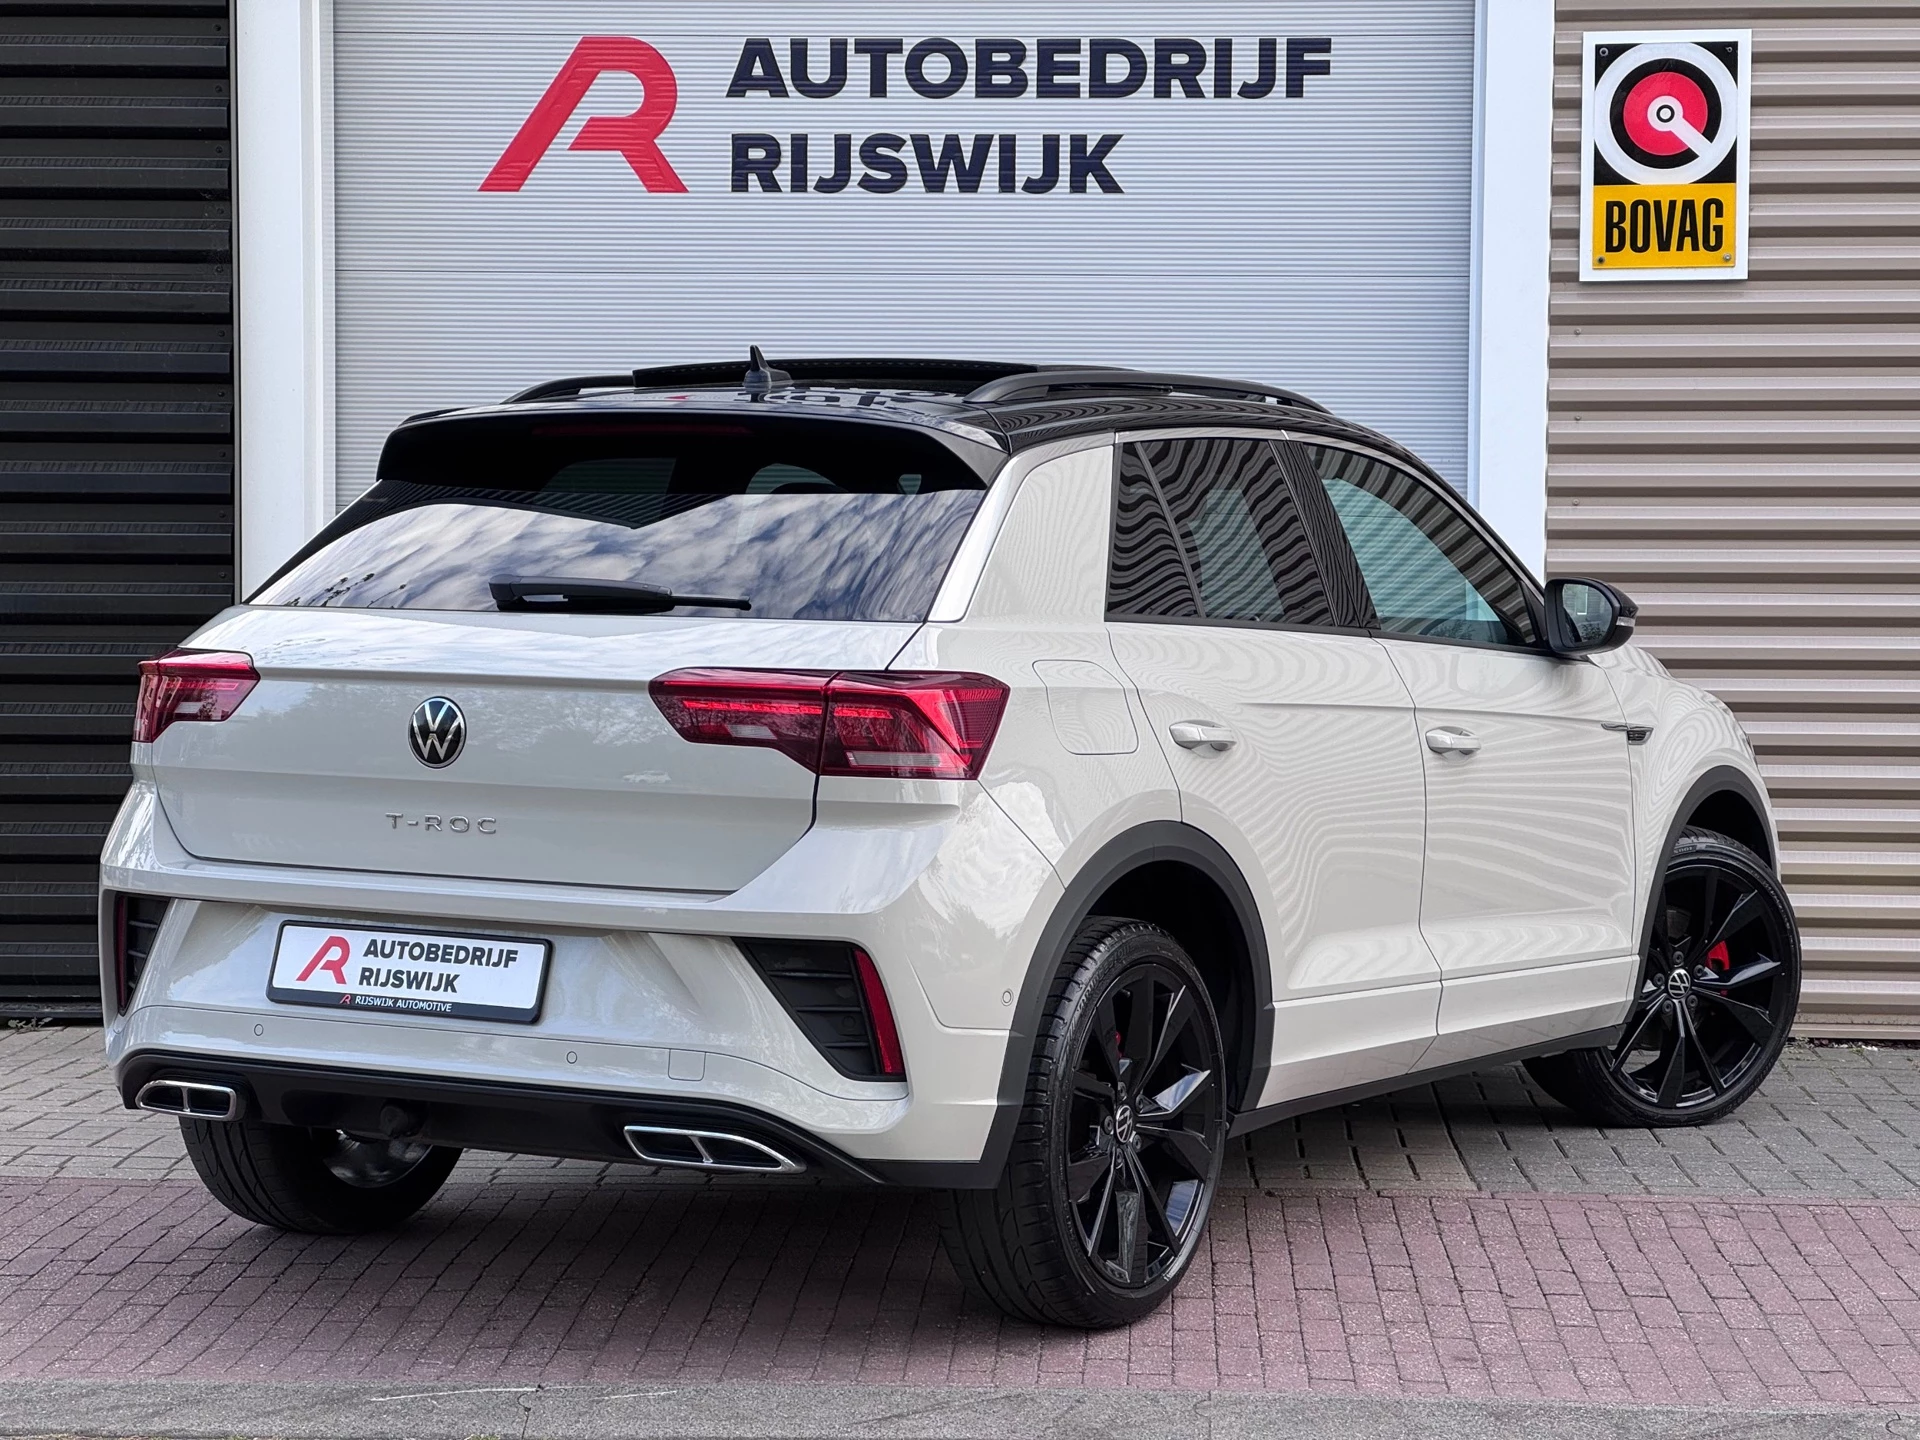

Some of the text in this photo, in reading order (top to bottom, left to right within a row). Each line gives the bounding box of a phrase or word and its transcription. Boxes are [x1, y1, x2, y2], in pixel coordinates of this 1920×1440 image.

[724, 37, 1332, 99] AUTOBEDRIJF
[730, 133, 1125, 194] RIJSWIJK
[1604, 198, 1724, 253] BOVAG
[385, 812, 497, 834] T-ROC
[363, 938, 519, 969] AUTOBEDRIJF
[358, 967, 461, 993] RIJSWIJK
[355, 995, 453, 1012] RIJSWIJK AUTOMOTIVE
